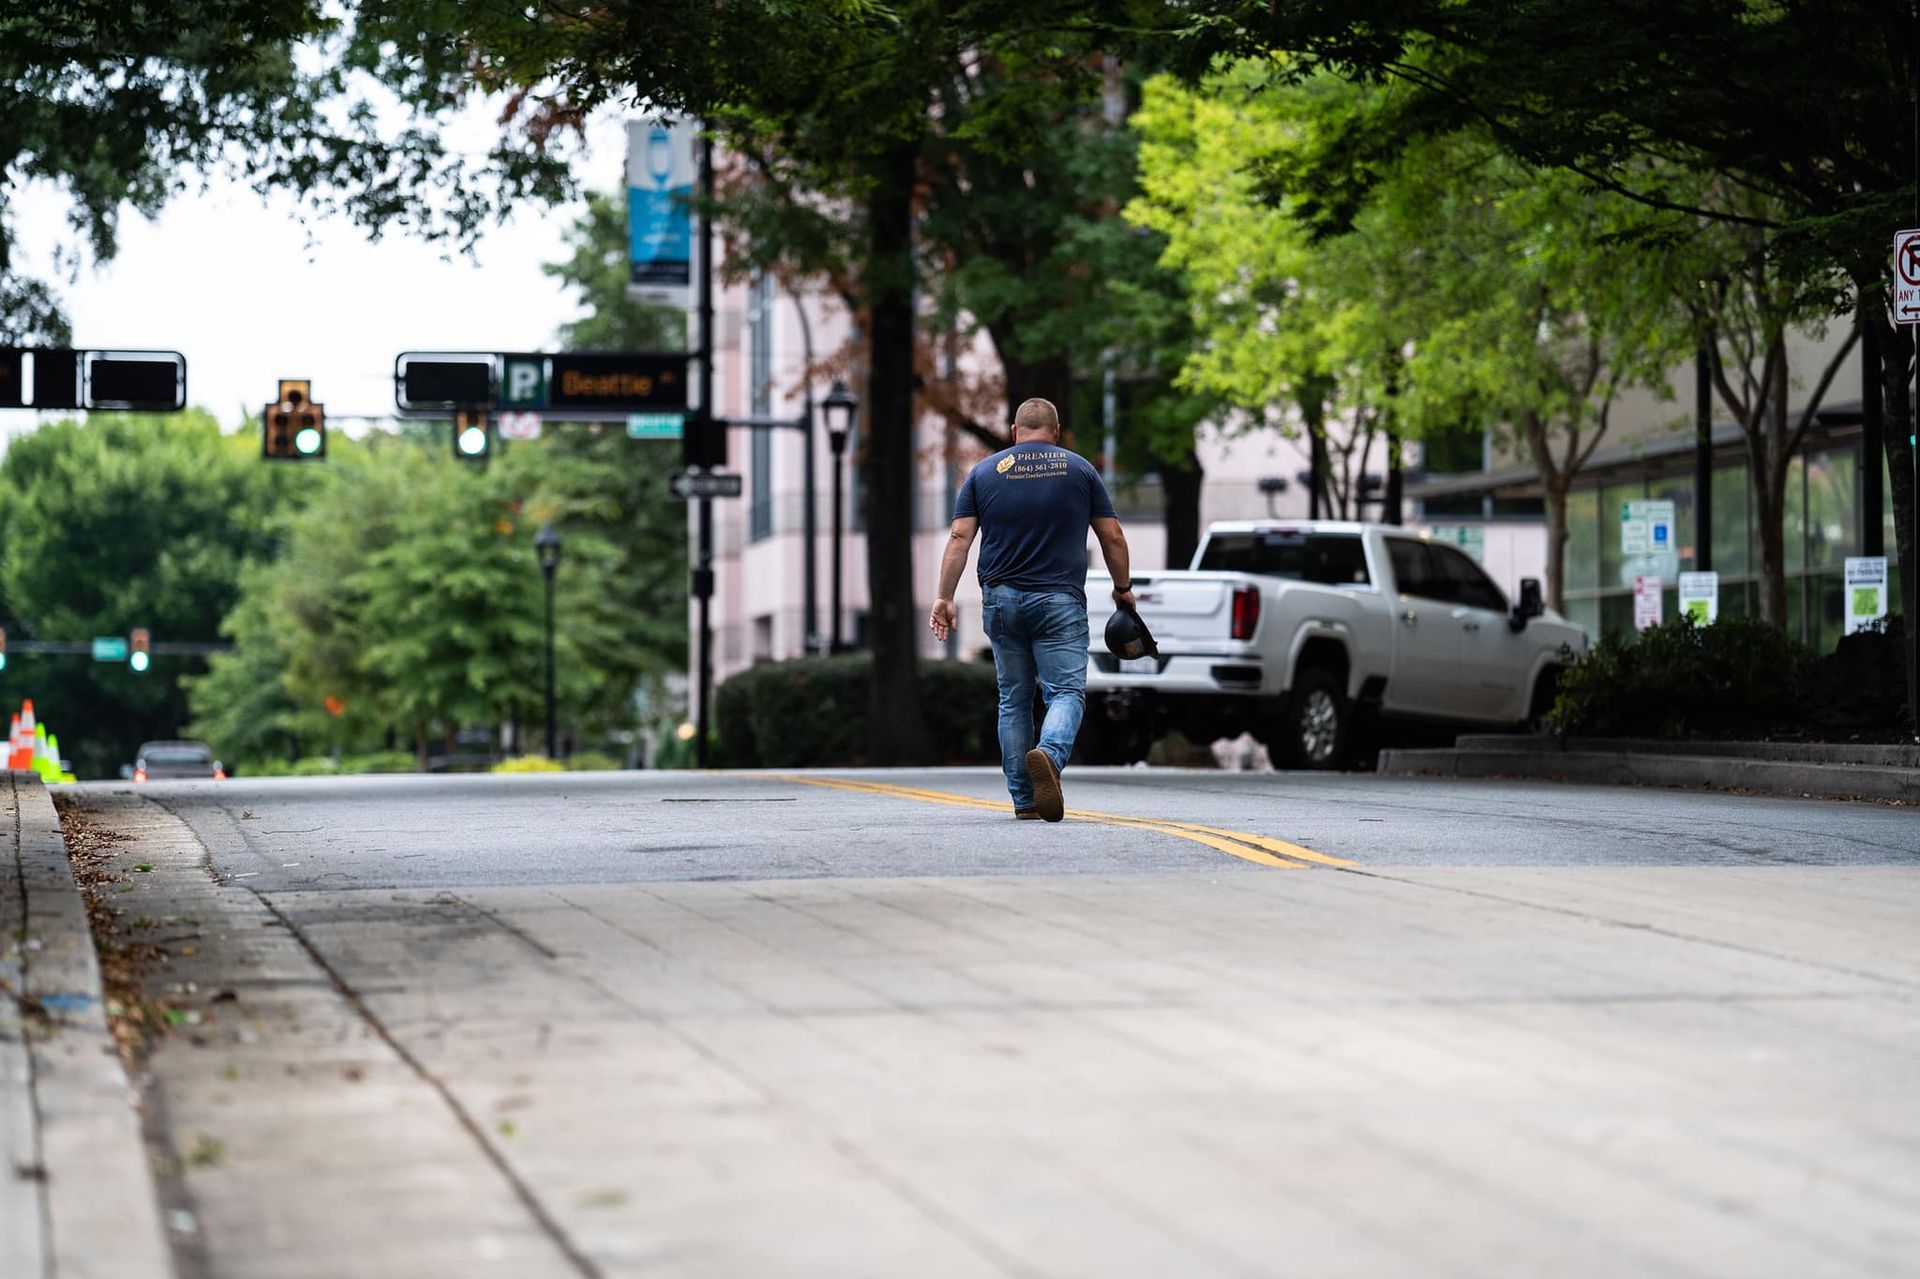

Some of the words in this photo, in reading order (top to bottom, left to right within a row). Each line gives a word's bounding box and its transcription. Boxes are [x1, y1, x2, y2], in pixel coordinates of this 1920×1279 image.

[1899, 289, 1914, 302] ANY
[509, 363, 540, 400] P
[1018, 452, 1067, 460] PREMIER
[1015, 465, 1033, 474] (864)
